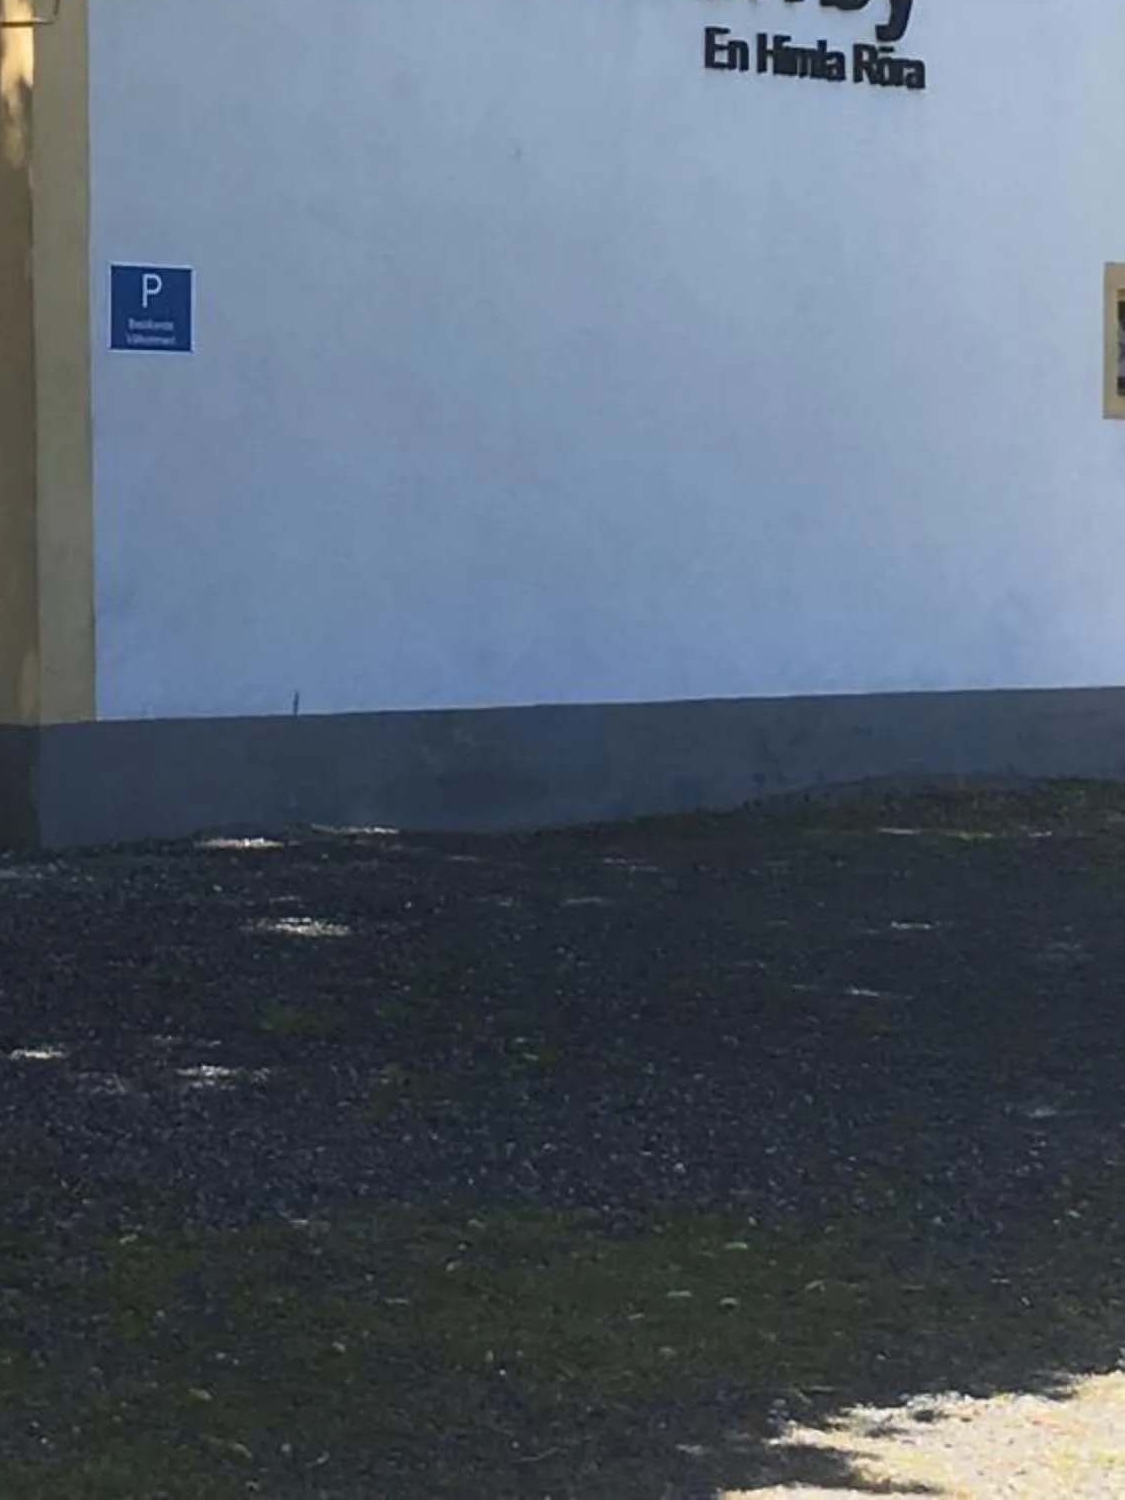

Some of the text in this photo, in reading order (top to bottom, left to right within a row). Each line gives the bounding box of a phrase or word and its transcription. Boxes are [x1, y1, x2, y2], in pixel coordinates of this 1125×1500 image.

[704, 26, 750, 73] En
[755, 32, 847, 83] Himla
[142, 273, 163, 309] P
